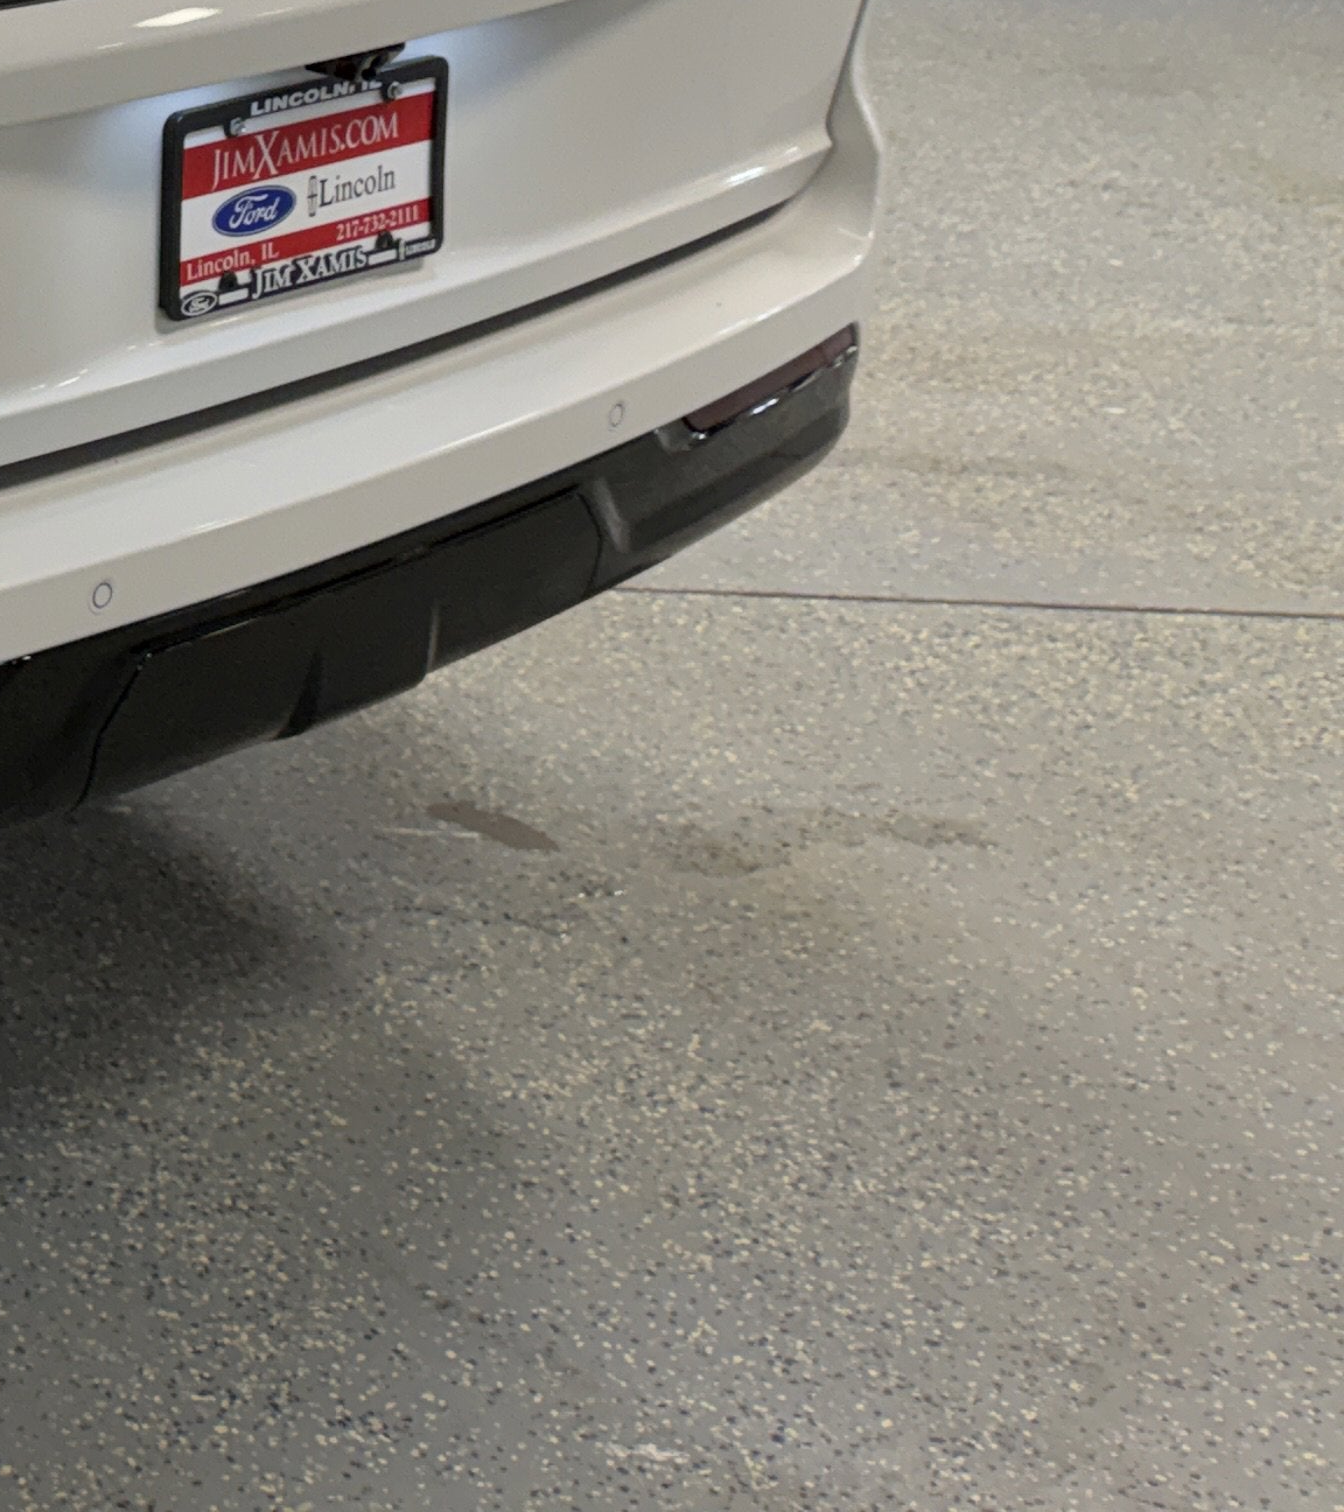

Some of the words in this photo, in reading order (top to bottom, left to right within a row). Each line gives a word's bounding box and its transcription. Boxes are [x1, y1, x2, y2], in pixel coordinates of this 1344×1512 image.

[211, 112, 399, 189] JIMXAMIS.COM
[319, 165, 396, 208] Lincoln
[228, 192, 280, 230] Ford
[335, 204, 419, 241] 217-732-2111
[261, 241, 280, 261] IL
[251, 266, 296, 299] JIM
[296, 246, 368, 285] XAMIS
